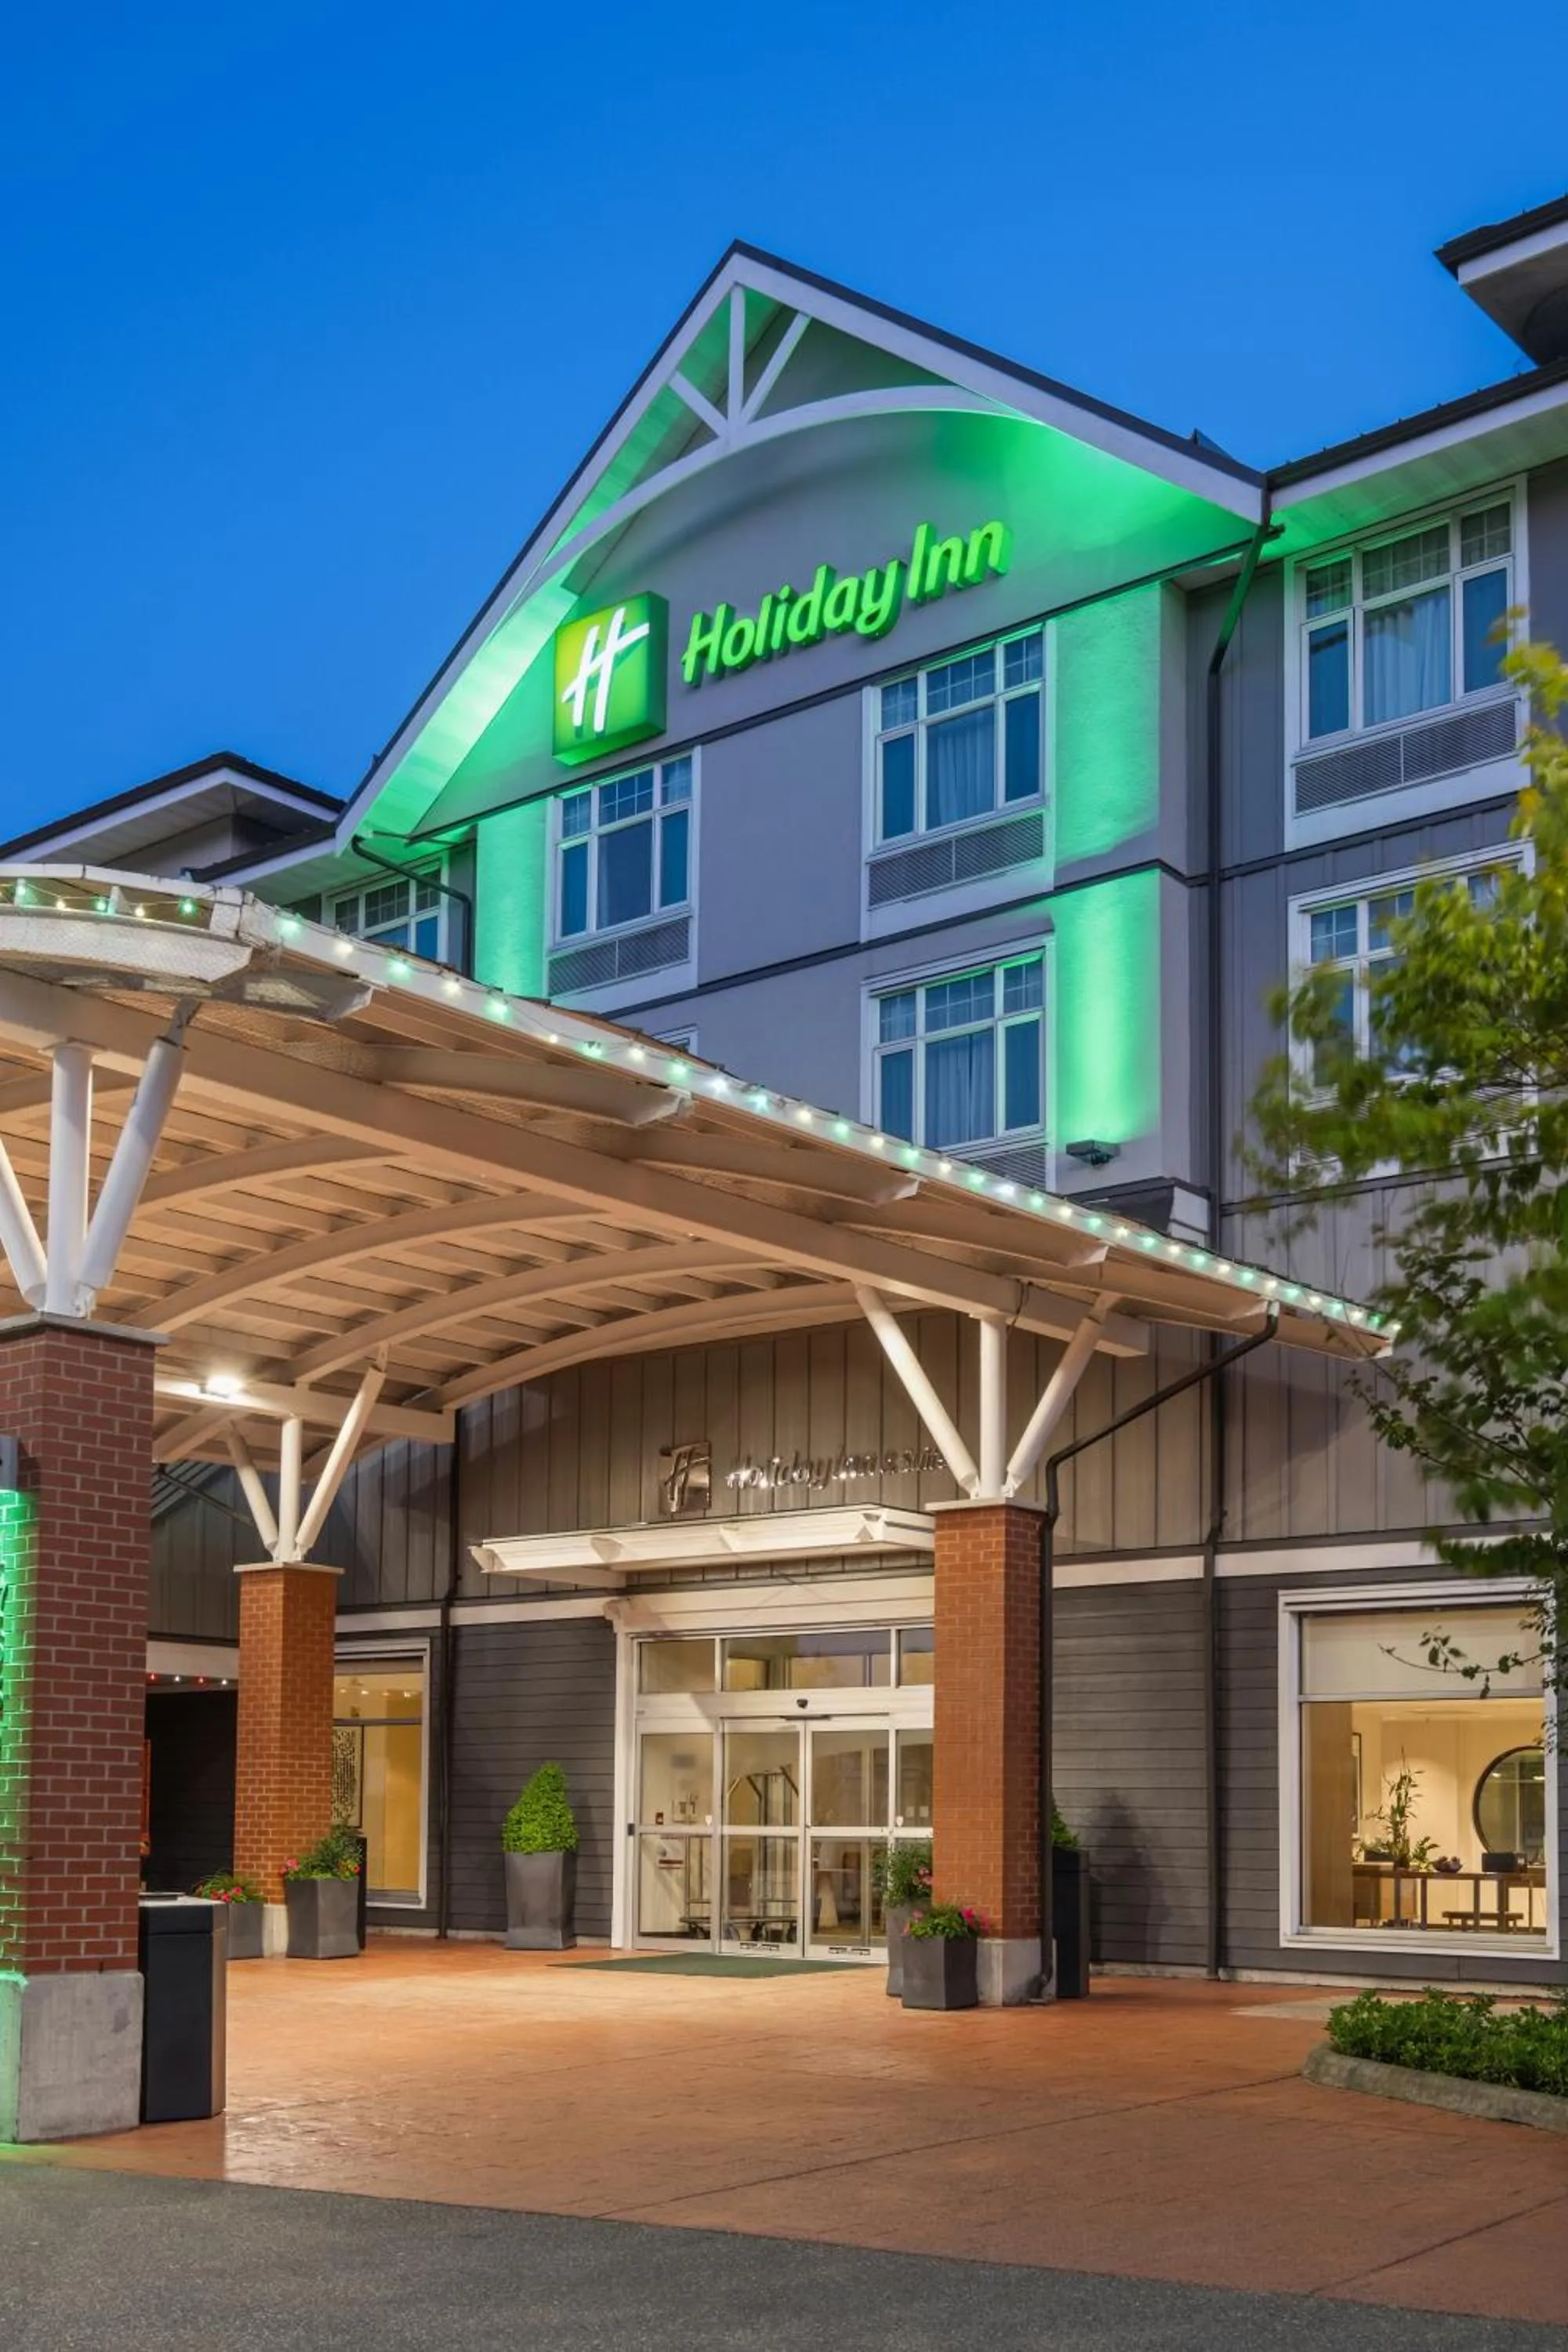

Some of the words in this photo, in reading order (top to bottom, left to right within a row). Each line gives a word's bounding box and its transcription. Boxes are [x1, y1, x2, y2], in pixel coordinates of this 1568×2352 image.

[681, 560, 906, 687] Holiday
[906, 521, 1011, 604] Inn
[561, 608, 650, 732] H
[725, 1450, 833, 1490] Holiday
